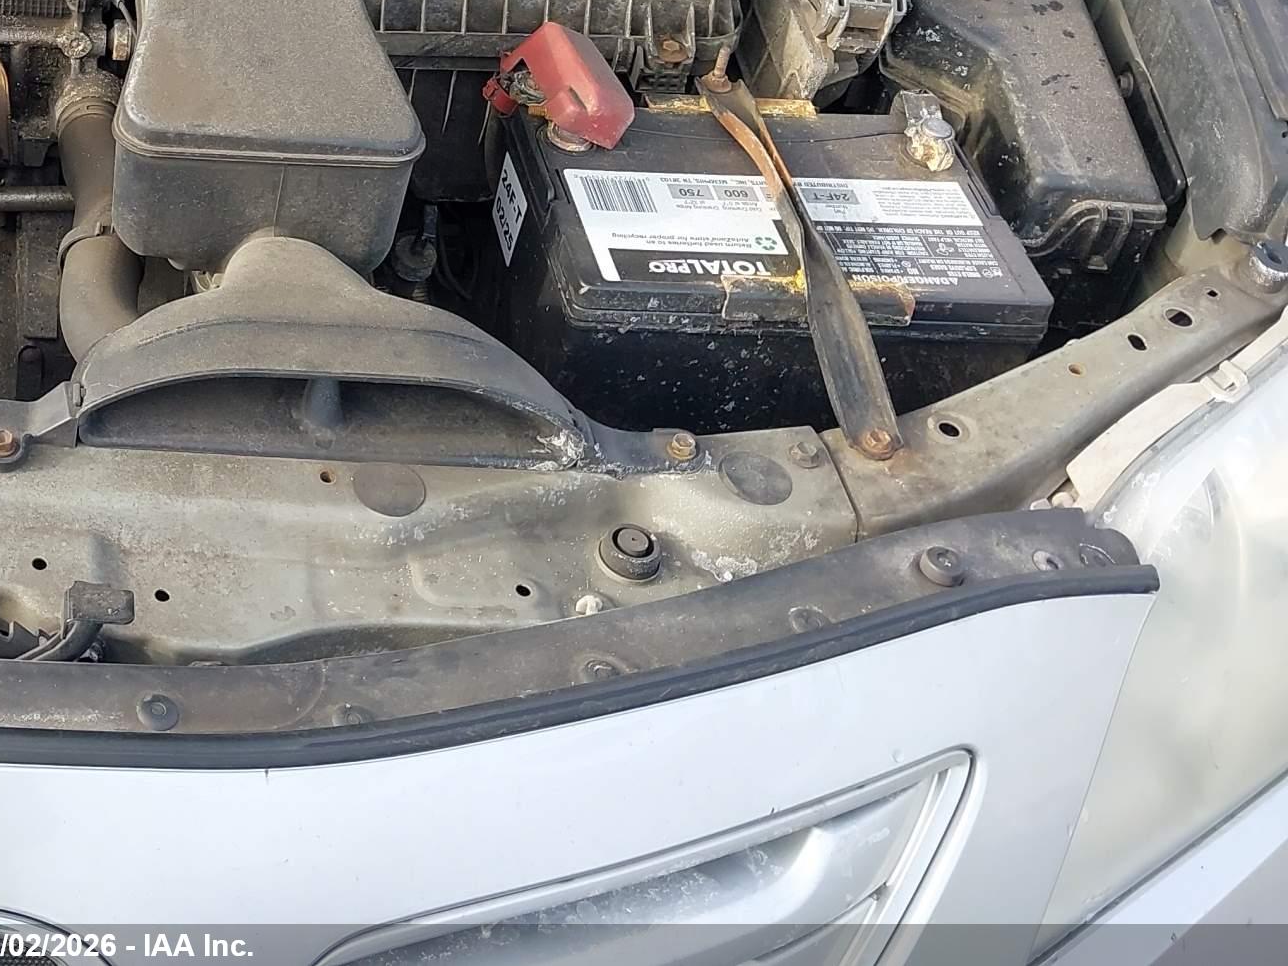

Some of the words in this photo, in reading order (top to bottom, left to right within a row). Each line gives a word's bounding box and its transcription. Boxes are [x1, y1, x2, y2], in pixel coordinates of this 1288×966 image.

[501, 169, 522, 224] 24F-T
[679, 188, 704, 197] 750
[724, 190, 748, 198] 600
[813, 193, 850, 201] 24F-T
[495, 197, 514, 252] 02/25
[648, 259, 771, 275] TOTALPRO
